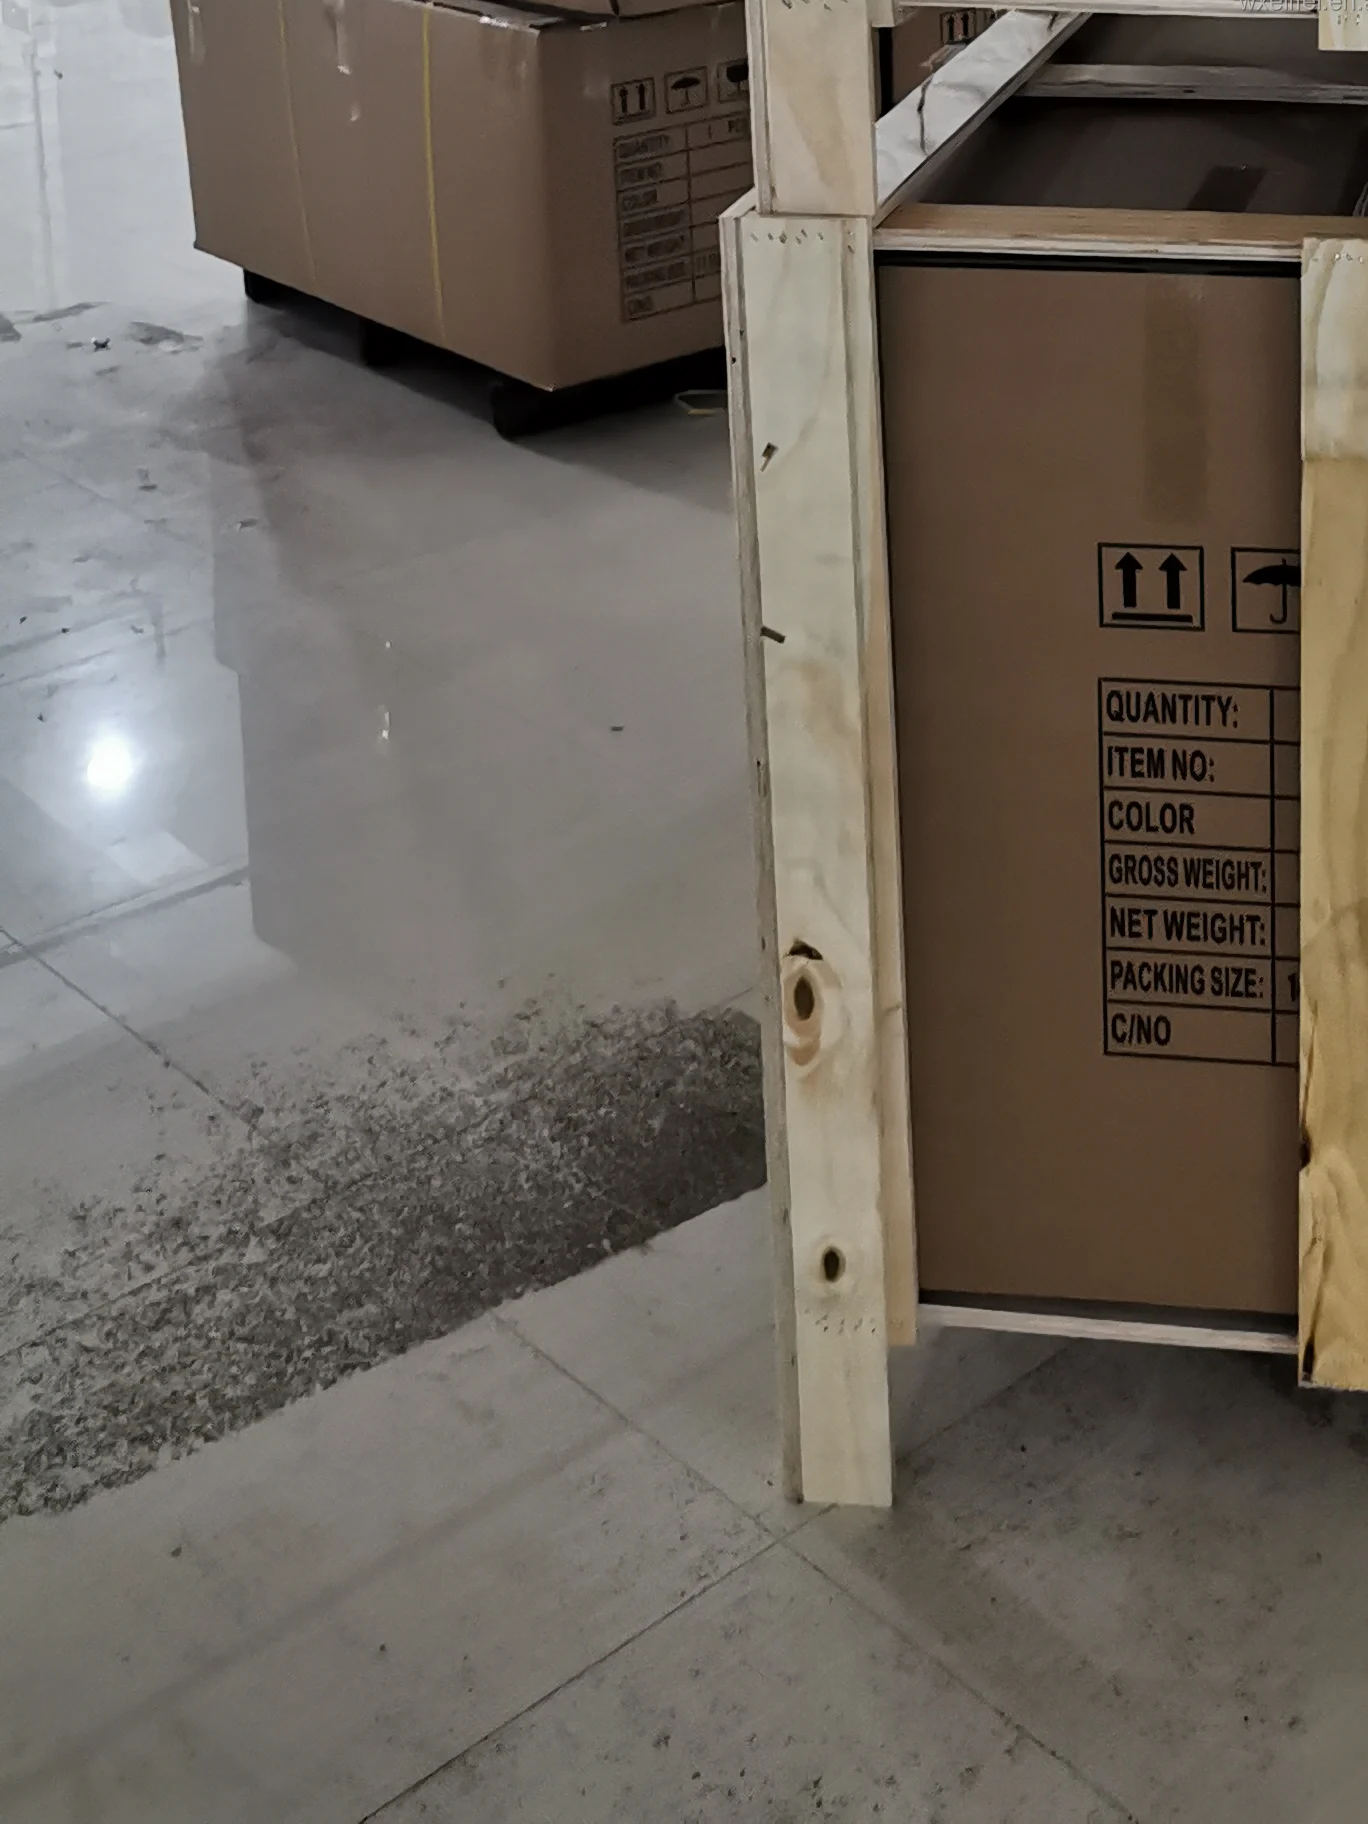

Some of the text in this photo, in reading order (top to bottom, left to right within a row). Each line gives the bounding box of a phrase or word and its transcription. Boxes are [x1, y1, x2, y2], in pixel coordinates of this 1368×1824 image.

[1106, 690, 1238, 728] QUANTITY:
[1107, 745, 1215, 782] ITEM NO:
[1108, 800, 1195, 835] COLOR
[1108, 853, 1267, 893] GROSS WEIGHT:
[1110, 906, 1266, 946] NET WEIGHT:
[1110, 960, 1264, 999] PACKING SIZE:
[1111, 1014, 1171, 1046] C/NO
